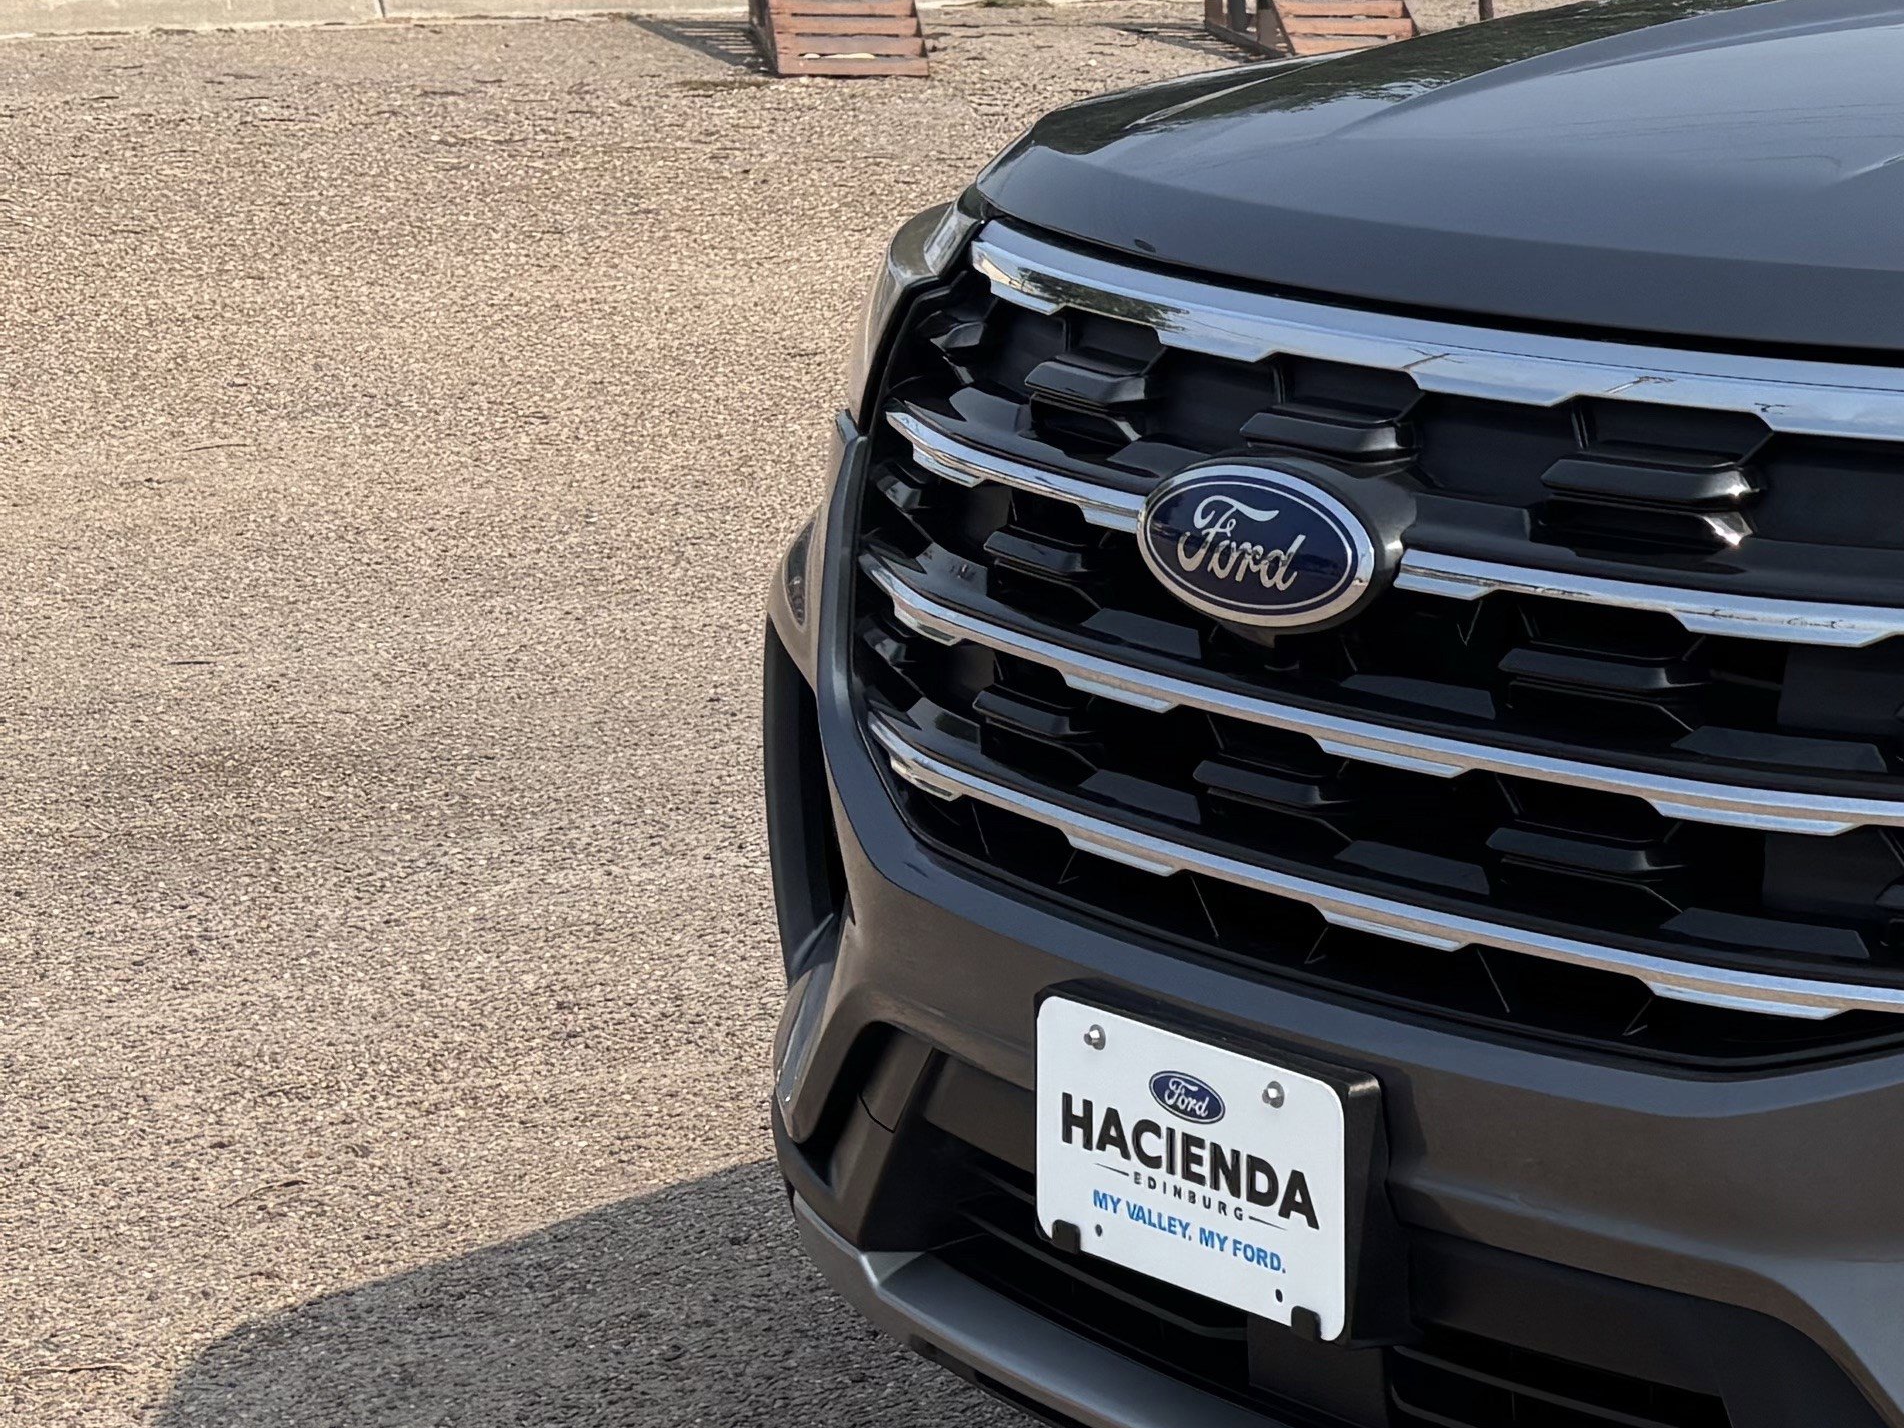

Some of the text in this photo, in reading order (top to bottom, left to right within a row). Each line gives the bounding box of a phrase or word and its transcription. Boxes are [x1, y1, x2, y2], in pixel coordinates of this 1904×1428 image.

[1177, 494, 1306, 592] Ford
[1164, 1075, 1210, 1117] Ford
[1060, 1091, 1321, 1231] HACIENDA
[1132, 1171, 1245, 1222] EDINBURG
[1091, 1188, 1288, 1274] MY VALLEY. MY FORD.
